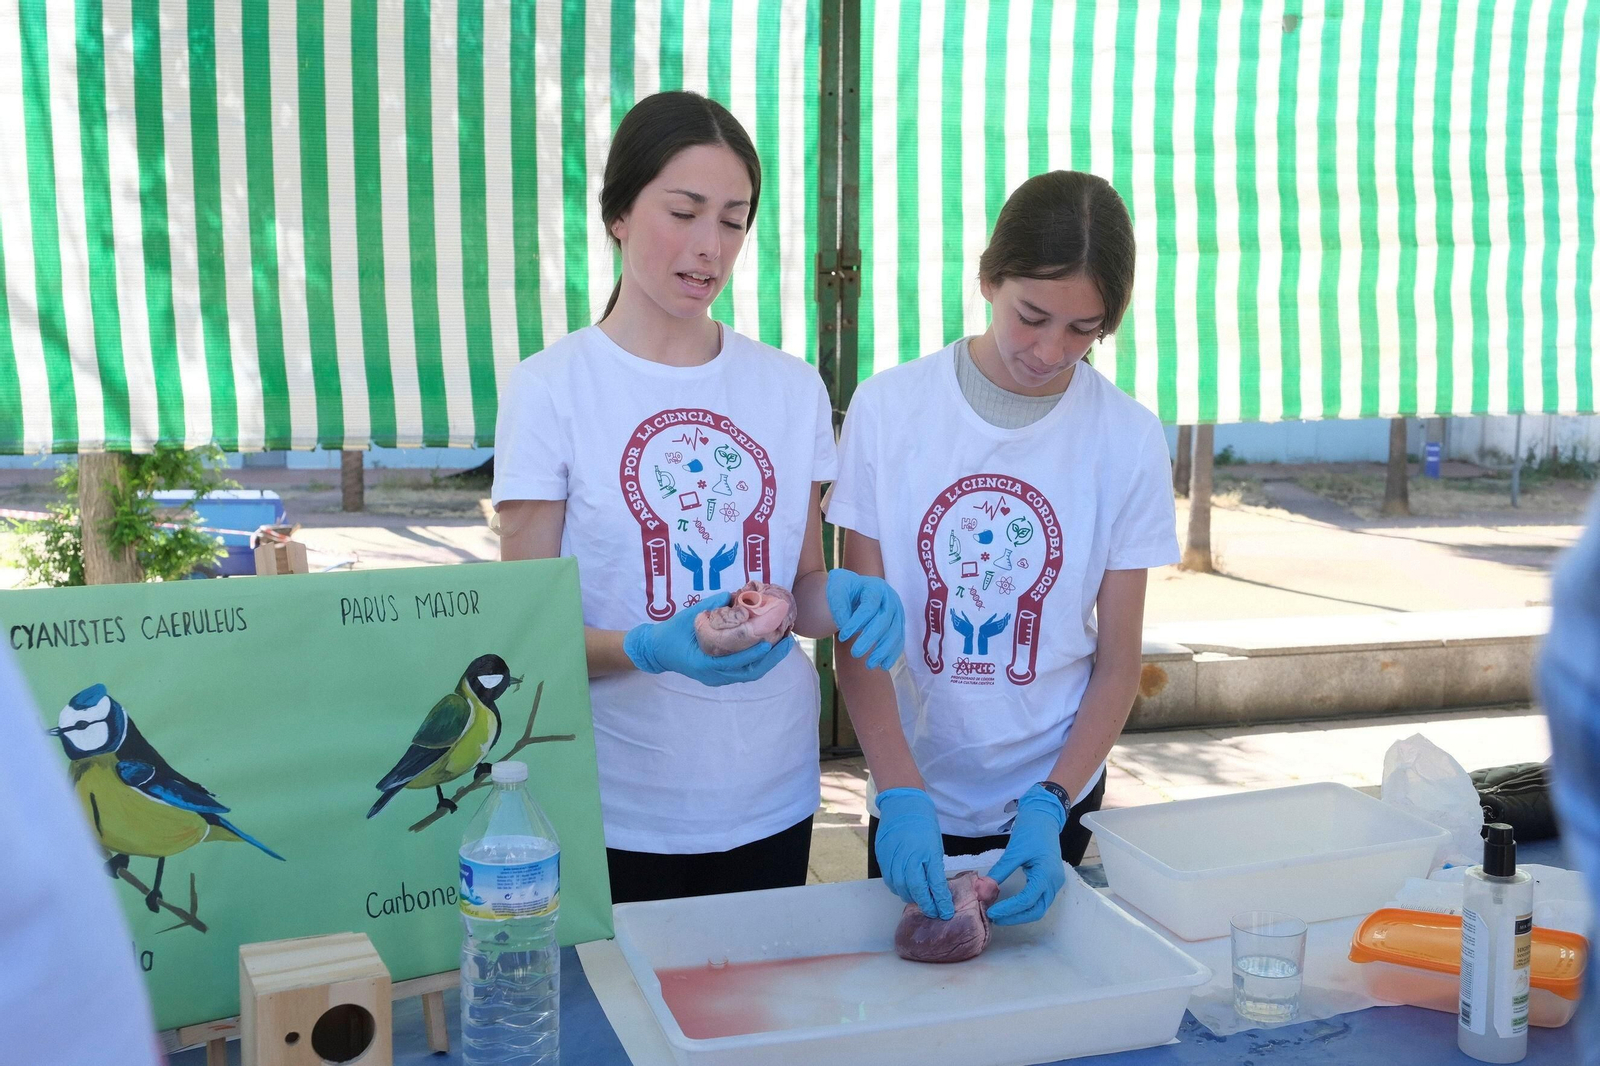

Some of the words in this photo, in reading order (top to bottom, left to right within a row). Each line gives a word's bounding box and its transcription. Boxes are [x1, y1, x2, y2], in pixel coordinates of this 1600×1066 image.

[636, 425, 656, 441] LA
[654, 411, 715, 428] CIENCIA
[624, 447, 641, 477] POR
[720, 419, 773, 479] CÓRDOBA
[945, 486, 962, 502] LA
[961, 477, 1022, 495] CIENCIA
[625, 480, 660, 531] PASEO
[754, 486, 774, 524] 2023
[923, 504, 945, 535] POR
[1026, 491, 1060, 560] CÓRDOBA
[921, 539, 942, 591] PASEO
[1030, 567, 1057, 602] 2023
[340, 594, 399, 626] PARUS
[415, 589, 480, 620] MAJOR
[10, 615, 126, 650] CYANISTES
[141, 607, 248, 640] CAERULEUS
[366, 881, 458, 919] Carbone
